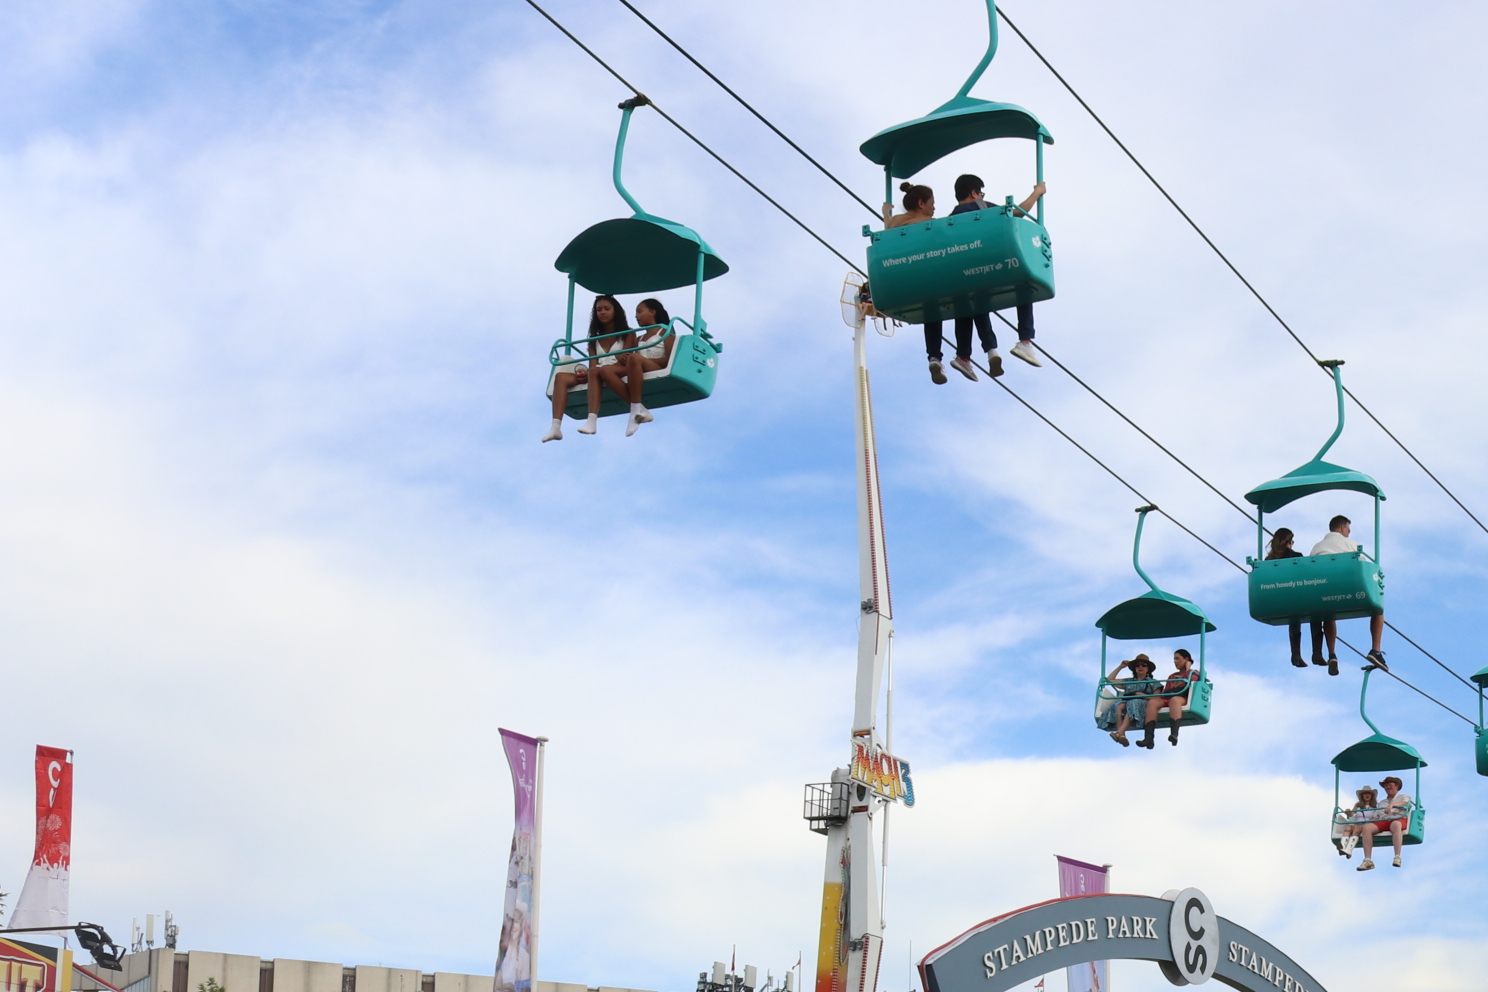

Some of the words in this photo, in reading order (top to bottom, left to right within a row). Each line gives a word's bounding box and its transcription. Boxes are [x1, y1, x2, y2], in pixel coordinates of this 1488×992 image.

[882, 258, 907, 268] Where
[908, 252, 925, 264] your
[926, 248, 946, 259] story
[947, 243, 968, 254] takes
[969, 240, 982, 250] off.
[963, 264, 995, 276] WESTJET
[1004, 257, 1020, 270] 70
[984, 918, 1098, 978] STAMPEDE
[1106, 915, 1159, 940] PARK
